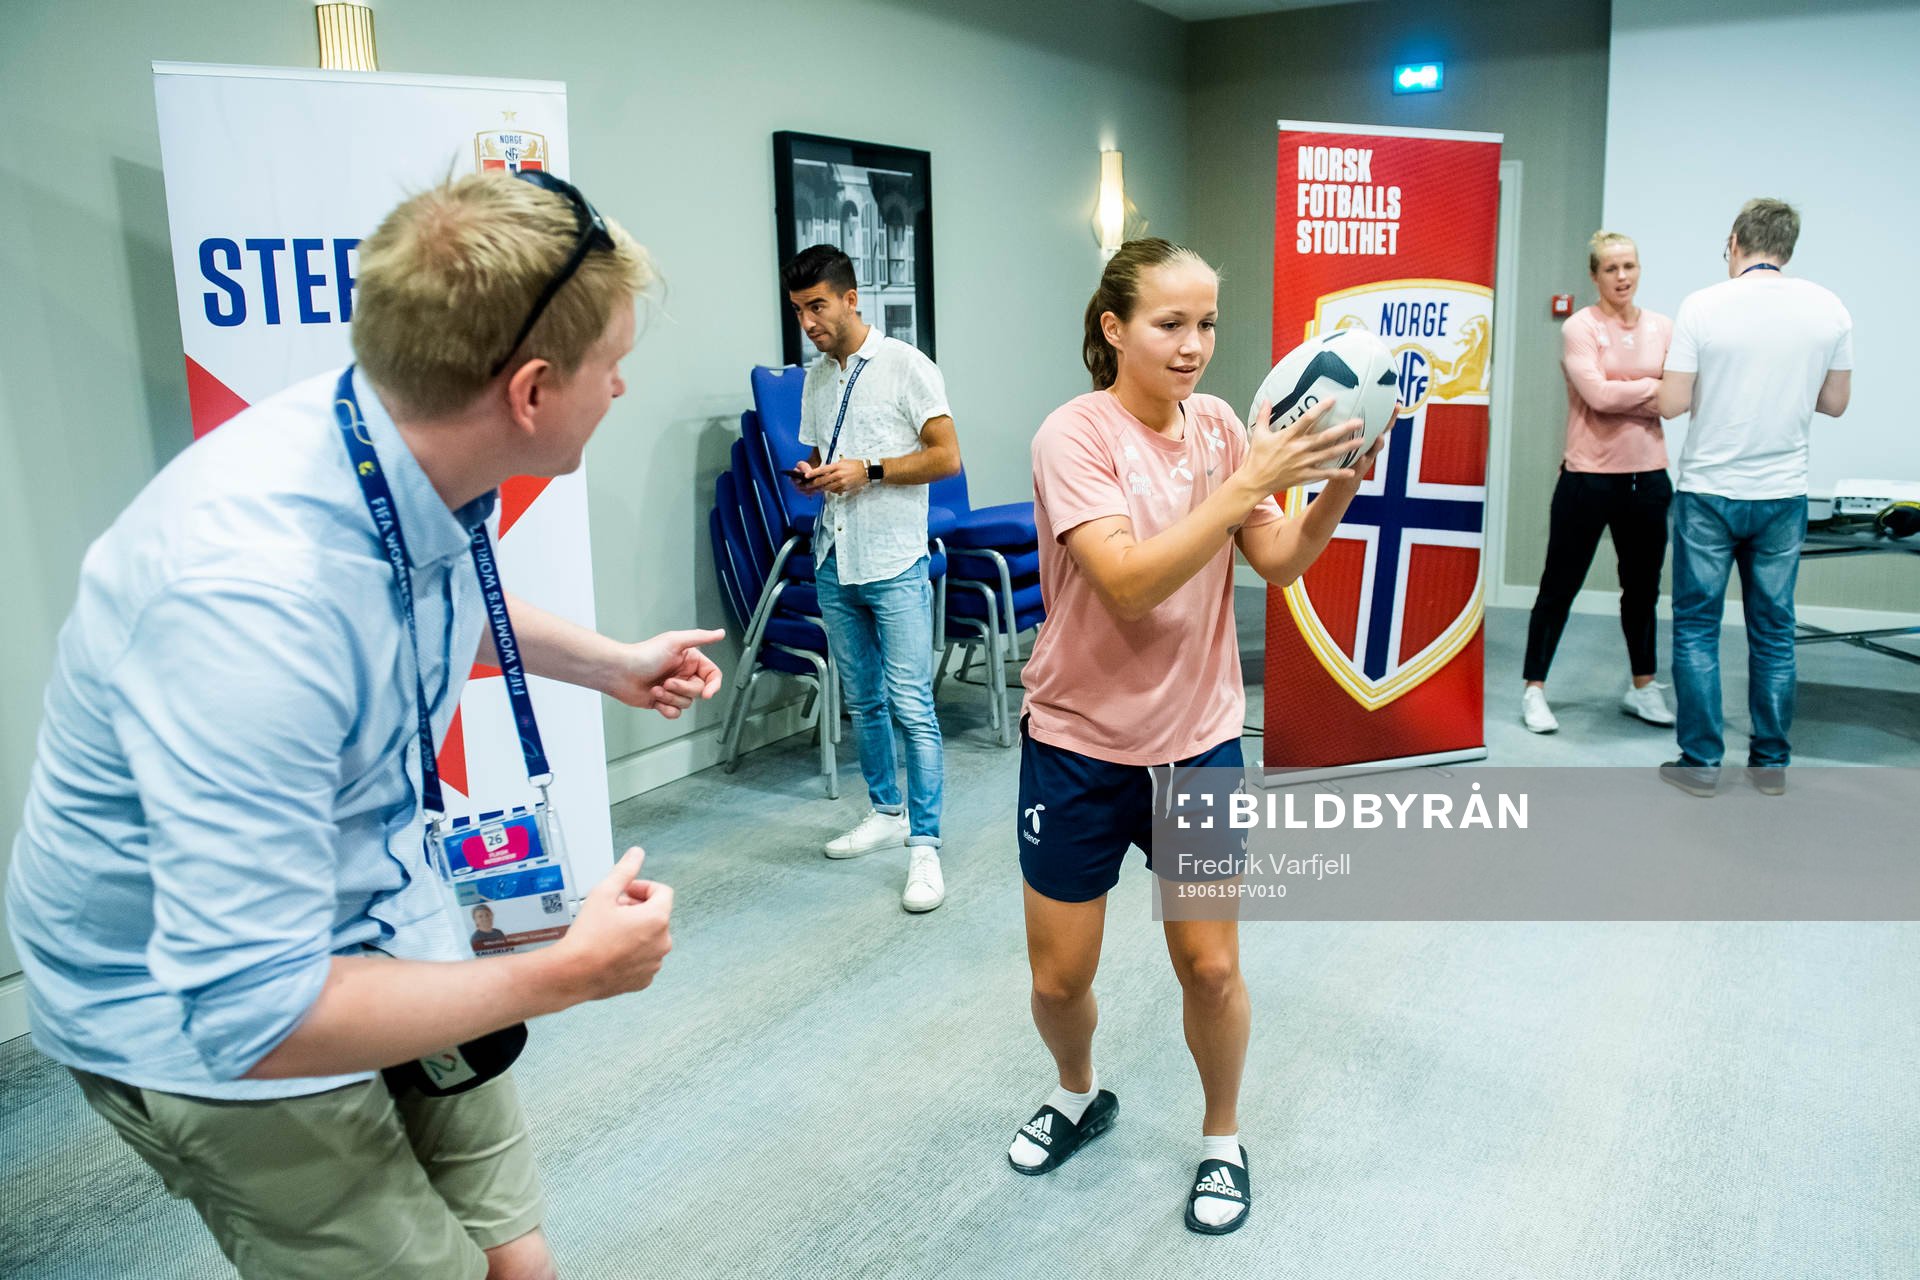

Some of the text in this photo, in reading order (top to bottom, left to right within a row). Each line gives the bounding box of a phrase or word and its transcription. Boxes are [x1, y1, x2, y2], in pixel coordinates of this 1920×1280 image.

[499, 135, 522, 144] NORGE
[1298, 146, 1373, 183] NORSK
[1297, 184, 1401, 220] FOTBALLS
[1296, 220, 1400, 255] STOLTHET
[1380, 302, 1450, 337] NORGE
[371, 497, 394, 532] FIFA
[472, 534, 497, 589] WORLD
[487, 591, 517, 663] WOMEN'S
[507, 665, 526, 695] FIFA
[487, 834, 503, 846] 26
[1023, 1124, 1053, 1146] adidas
[1196, 1180, 1243, 1199] adidas
